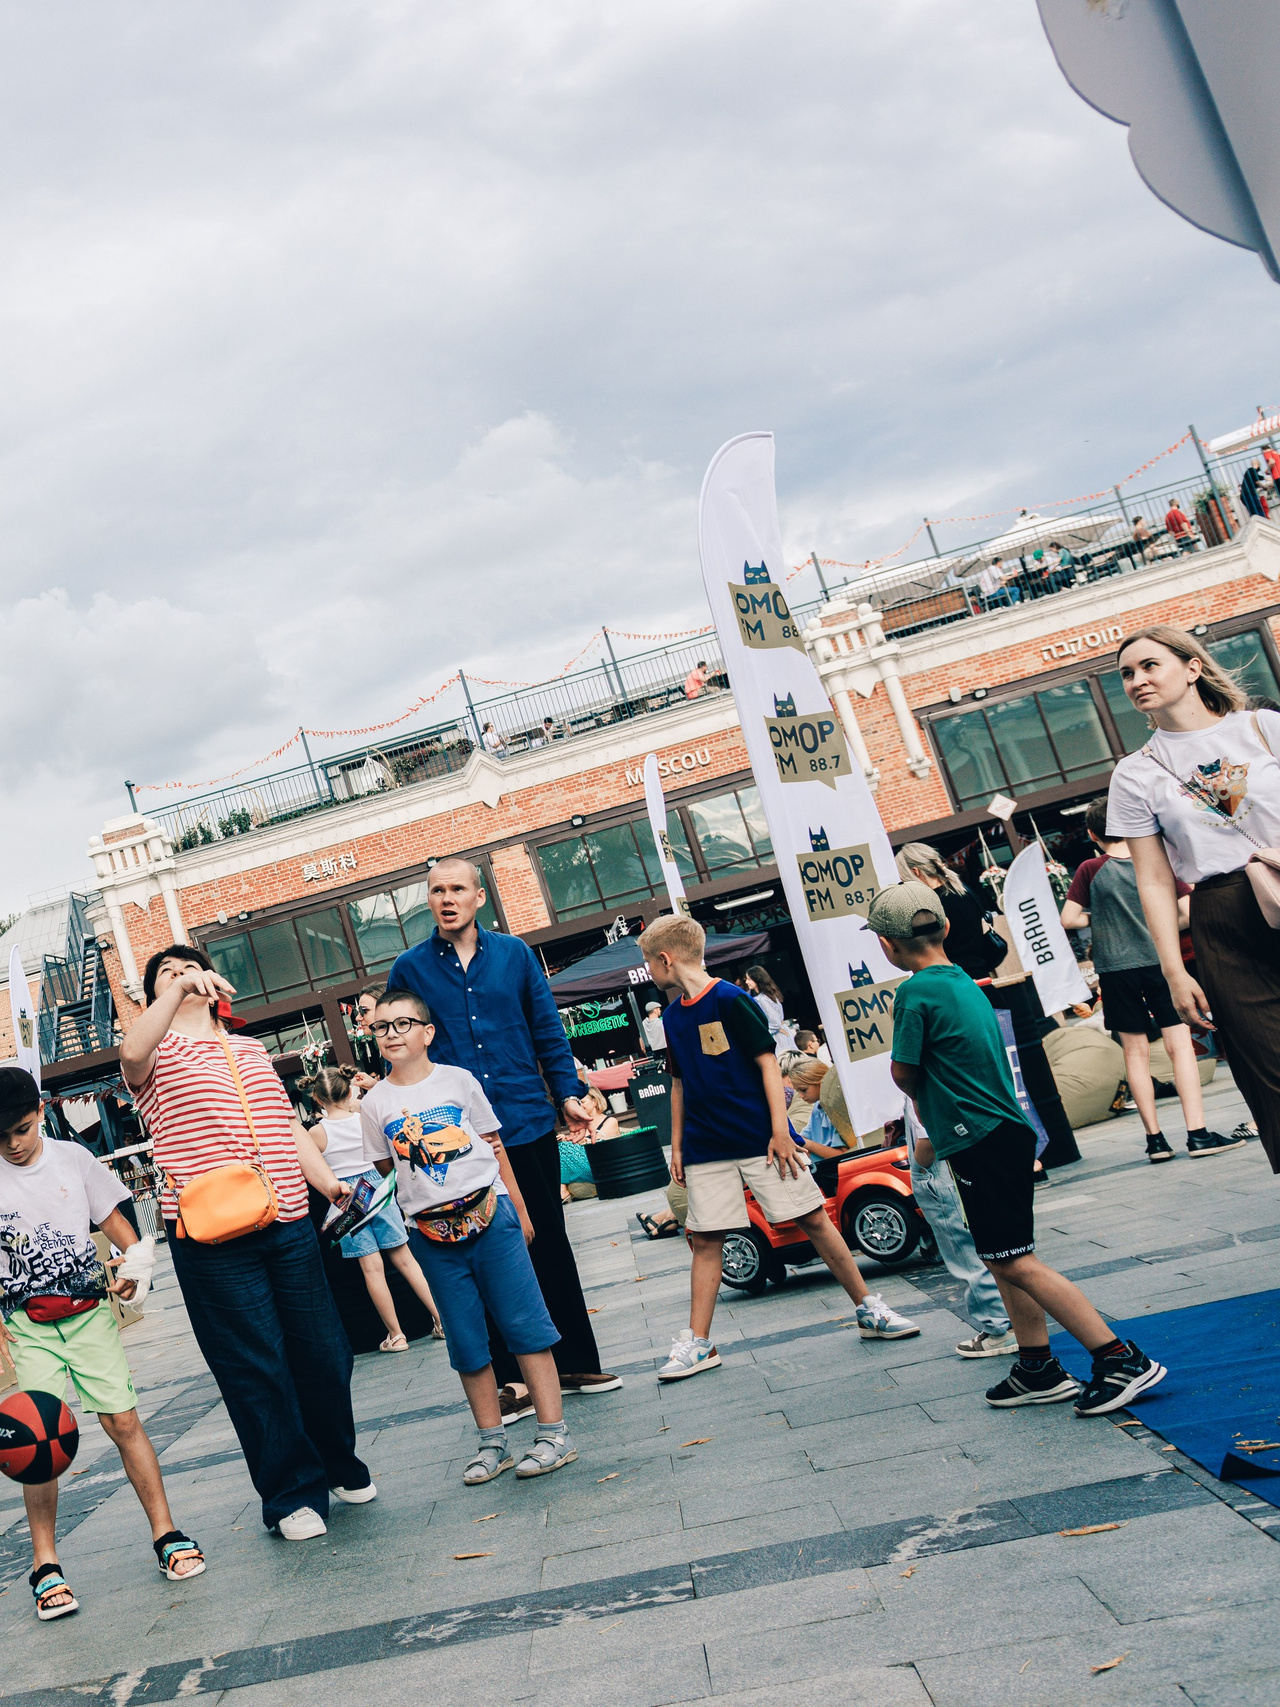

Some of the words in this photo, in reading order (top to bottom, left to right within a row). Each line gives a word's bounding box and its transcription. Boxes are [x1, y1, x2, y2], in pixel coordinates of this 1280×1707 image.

[1041, 626, 1124, 660] מוסקבה
[625, 748, 711, 787] MSCOU
[809, 755, 840, 772] 88.7
[302, 851, 357, 882] 莫斯科
[798, 854, 864, 887] ЮМОР
[805, 887, 835, 912] FM
[1018, 898, 1055, 965] BRAUN
[567, 1013, 629, 1040] SYNERGETIC
[846, 1022, 884, 1053] FM
[638, 1084, 666, 1099] BRAUN
[32, 1233, 49, 1245] HAS
[52, 1230, 62, 1239] NO
[34, 1222, 51, 1234] LIFE
[40, 1235, 76, 1252] REMOTE
[995, 1250, 1009, 1259] OUT
[1010, 1246, 1026, 1255] WHY
